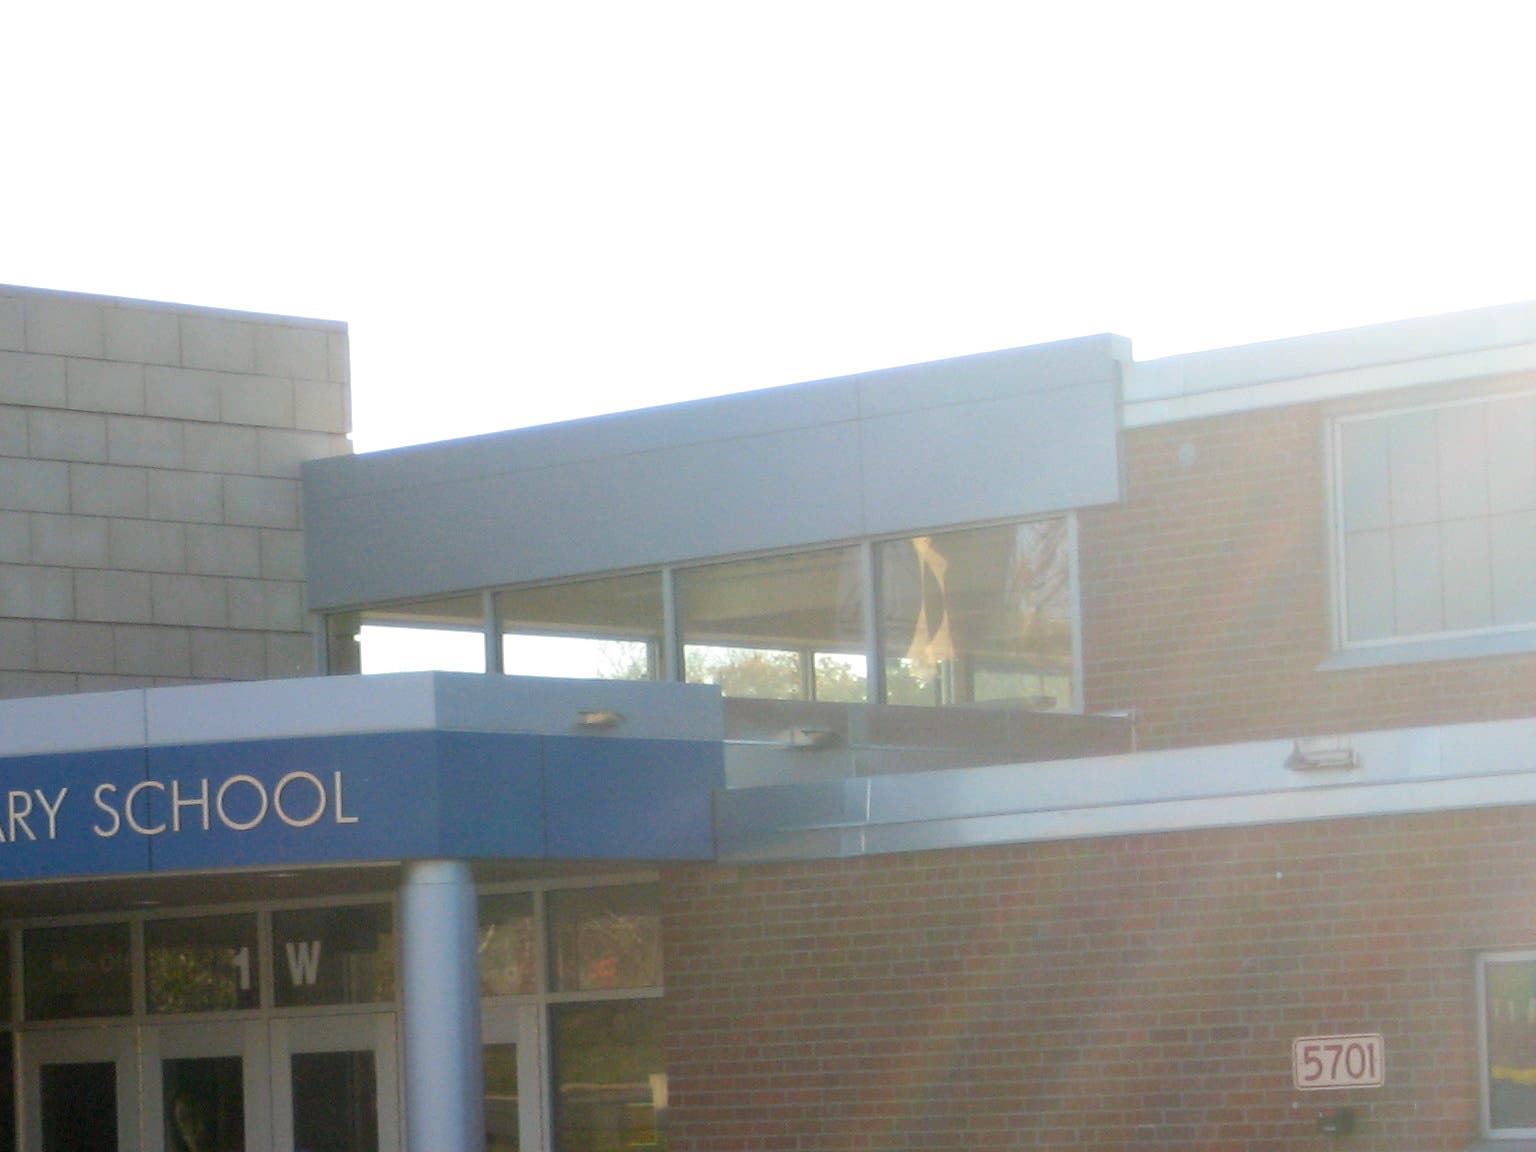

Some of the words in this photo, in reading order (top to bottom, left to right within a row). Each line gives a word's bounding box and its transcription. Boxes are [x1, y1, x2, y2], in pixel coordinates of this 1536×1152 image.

[93, 770, 359, 838] SCHOOL
[232, 947, 251, 990] 1
[285, 940, 322, 985] W
[1303, 1042, 1375, 1082] 5701
